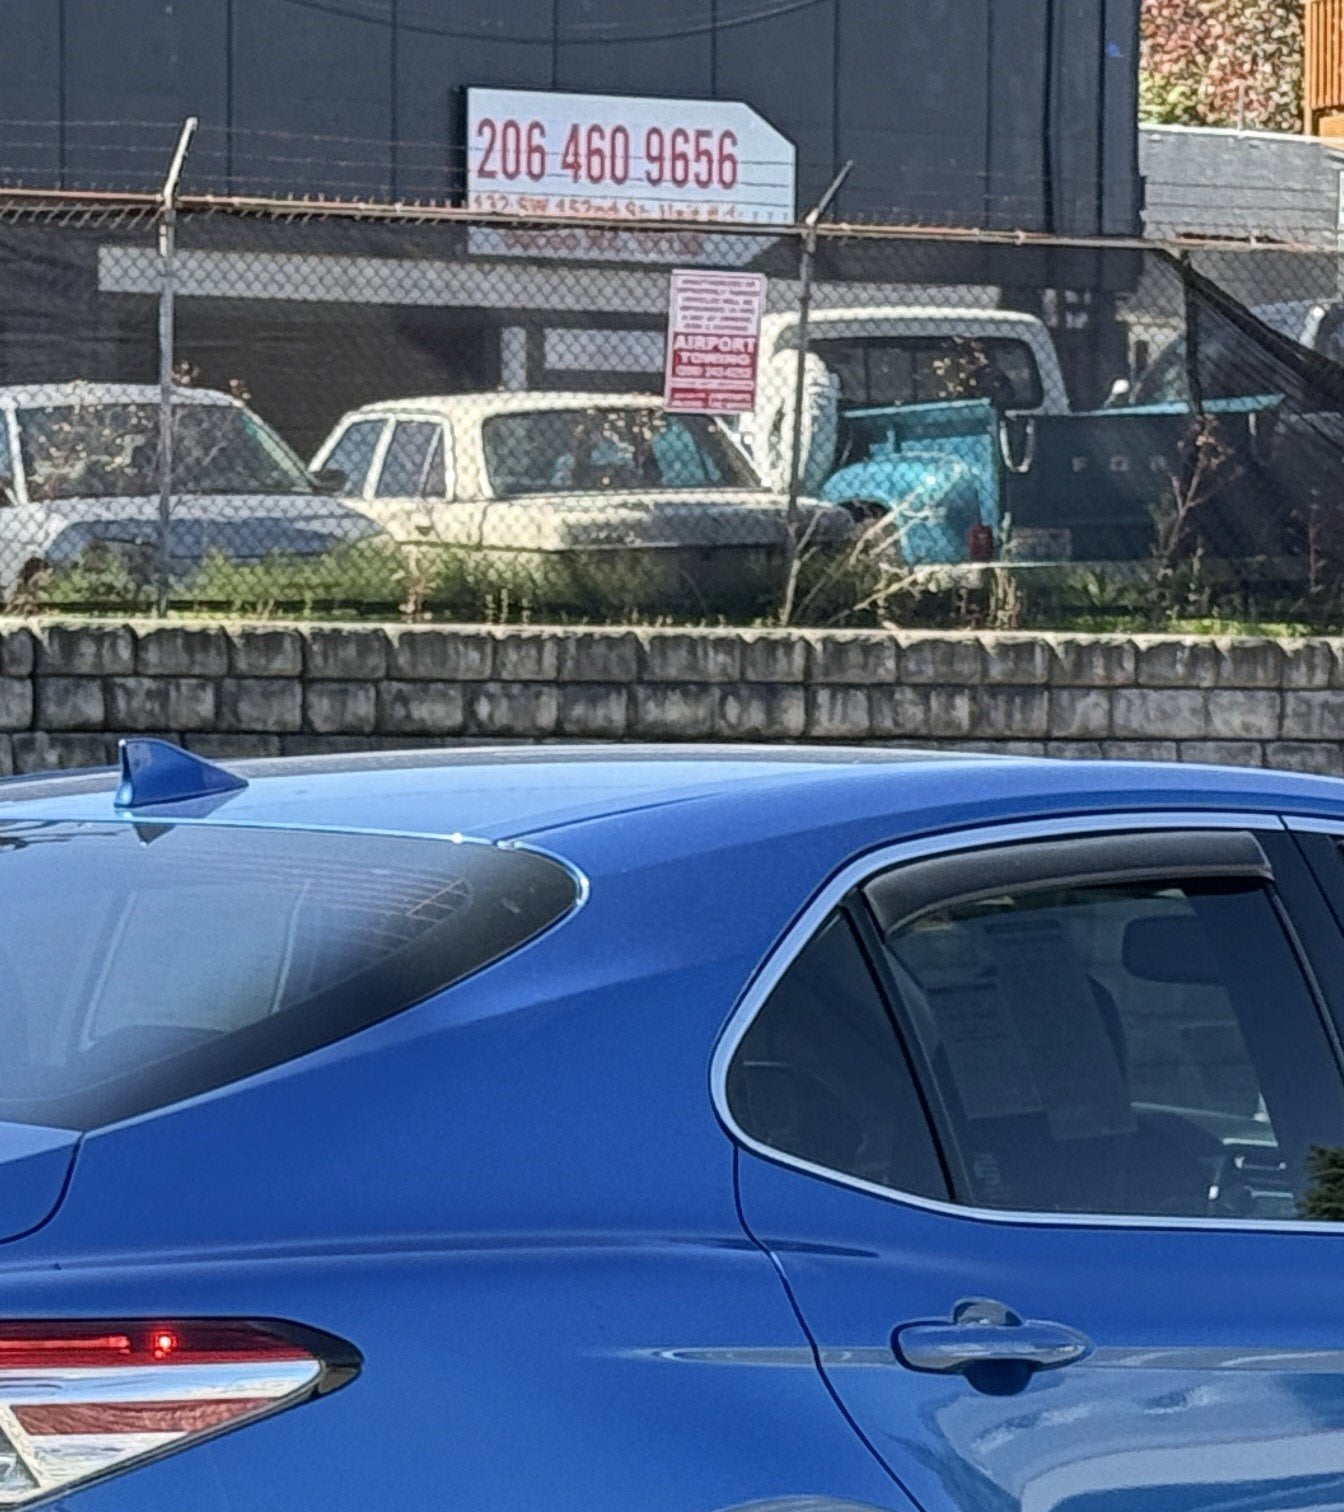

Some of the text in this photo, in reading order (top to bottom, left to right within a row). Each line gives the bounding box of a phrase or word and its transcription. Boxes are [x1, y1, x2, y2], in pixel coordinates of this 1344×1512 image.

[476, 117, 738, 190] 206 460 9656
[673, 335, 757, 353] AIRPORT
